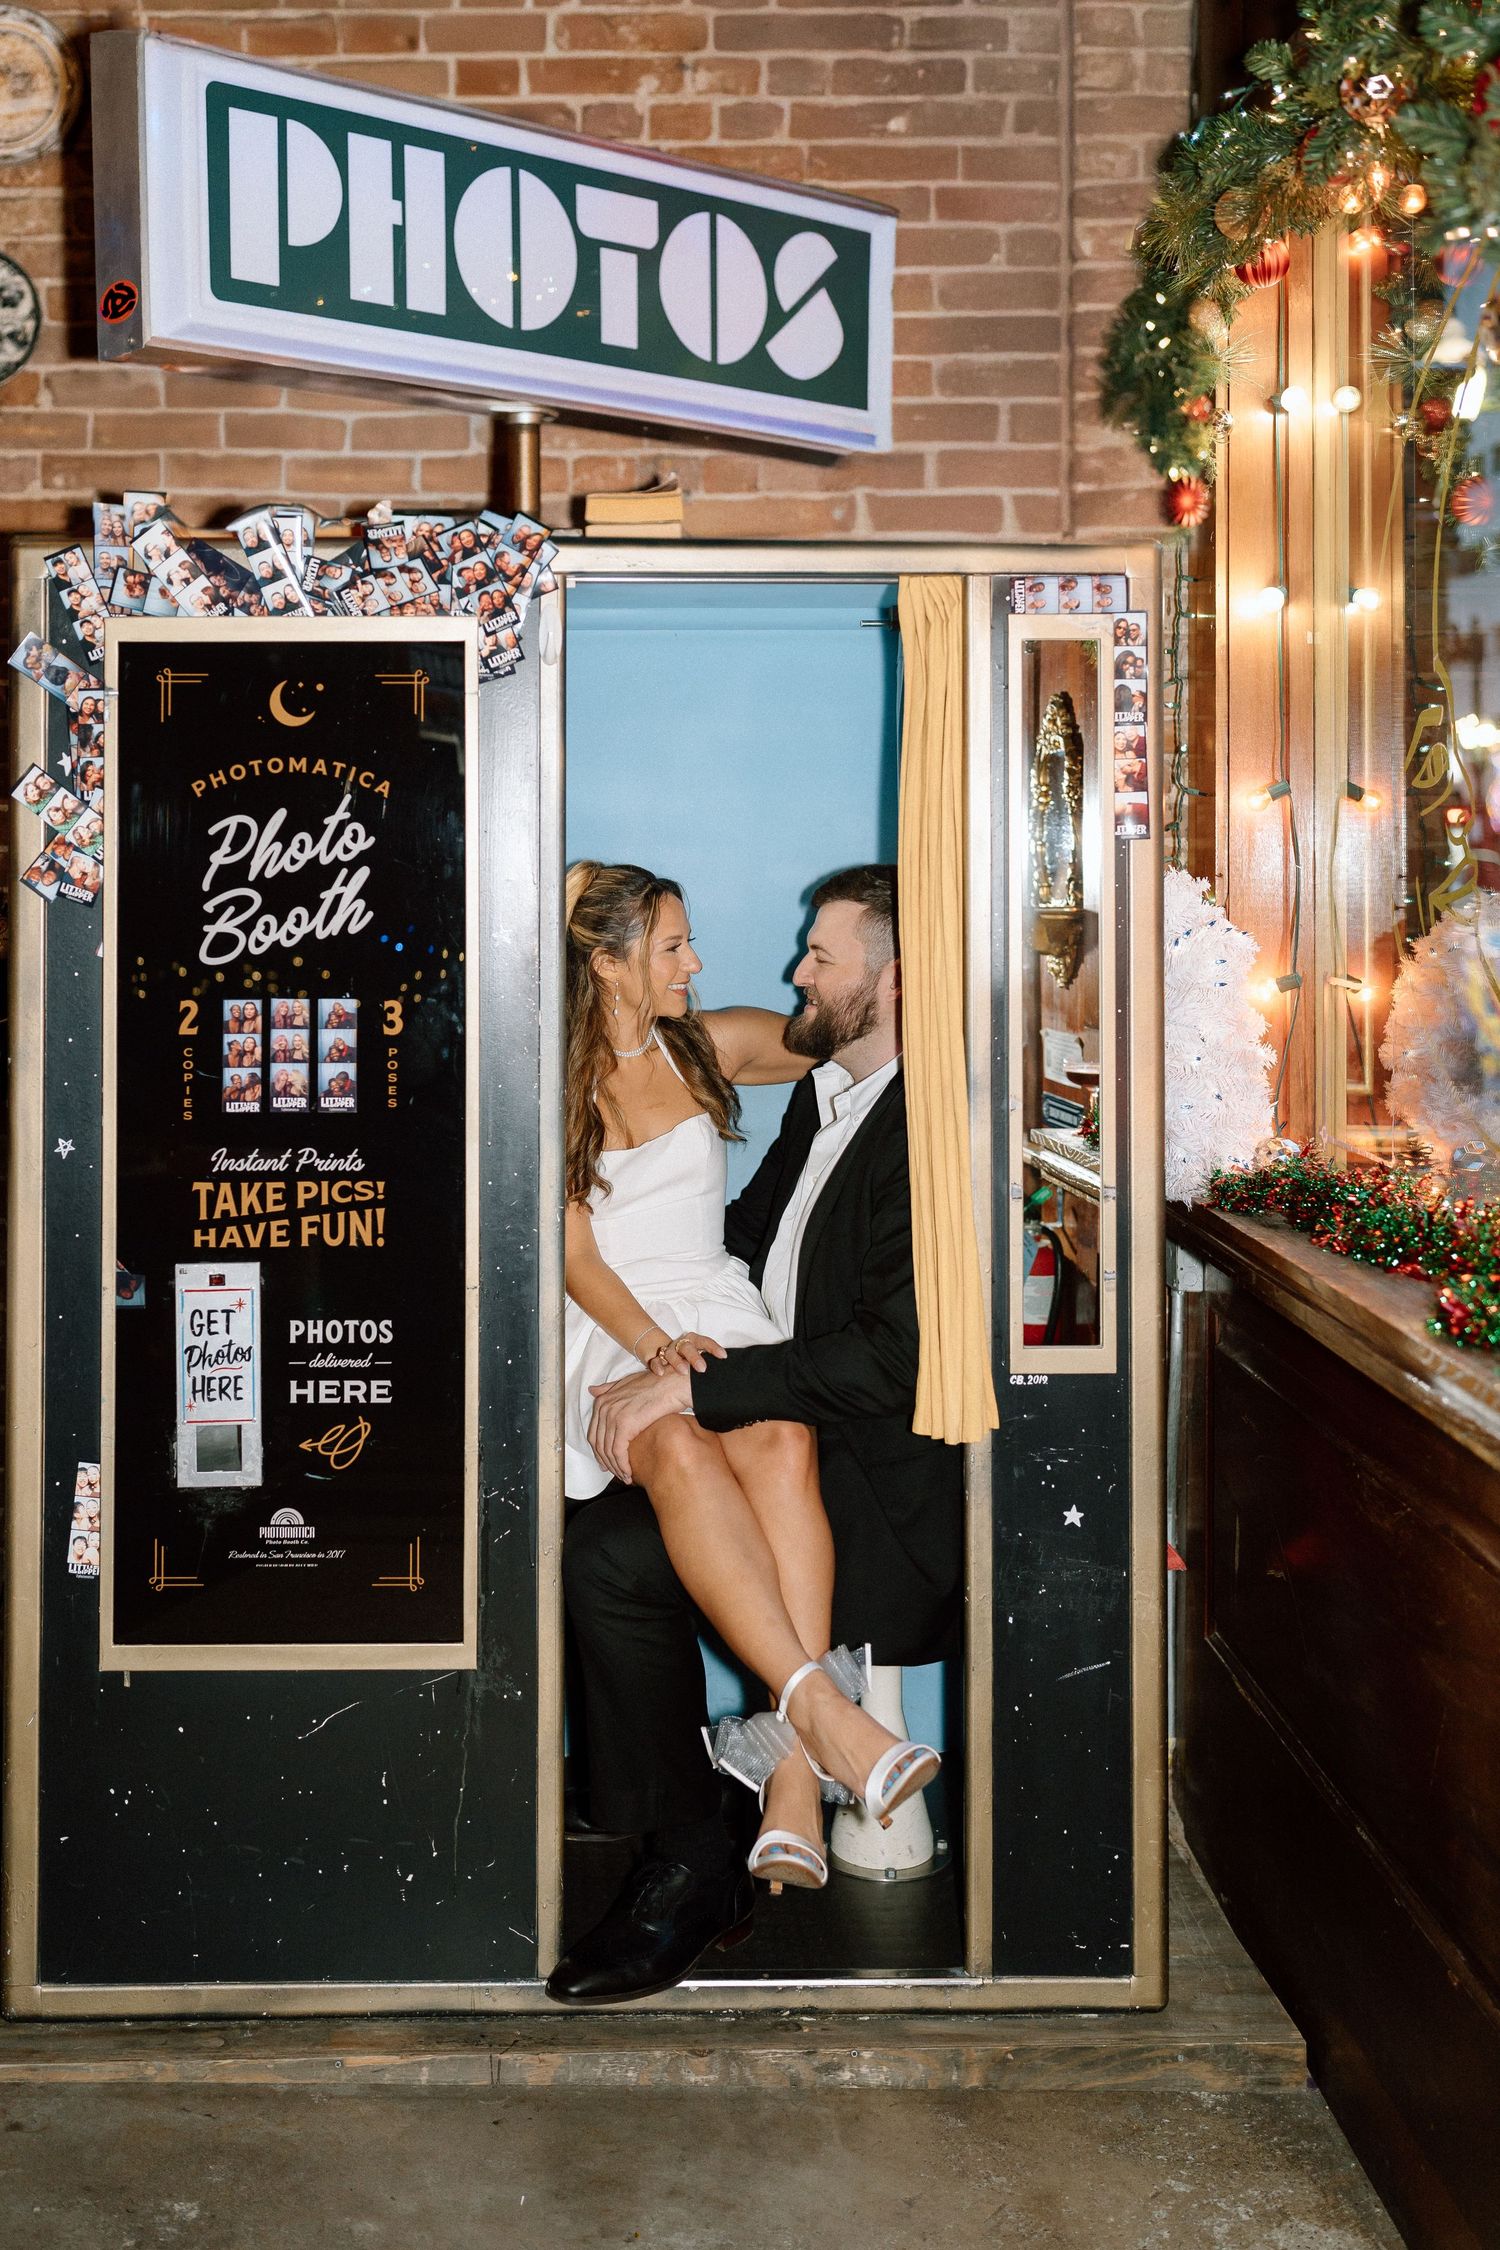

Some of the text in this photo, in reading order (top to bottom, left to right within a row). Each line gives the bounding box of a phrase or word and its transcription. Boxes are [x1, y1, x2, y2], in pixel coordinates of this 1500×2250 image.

[228, 106, 844, 381] PHOTOS
[191, 757, 391, 798] PHOTOMATICA
[202, 793, 376, 892] Photo
[198, 866, 374, 966] Booth
[178, 1000, 199, 1035] 2
[383, 1000, 404, 1036] 3
[183, 1047, 193, 1121] COPIES
[387, 1047, 398, 1108] POSES
[210, 1147, 366, 1173] Instant Prints
[192, 1180, 386, 1220] TAKE PICS!
[193, 1207, 386, 1248] HAVE FUN!
[189, 1308, 237, 1338] GET
[289, 1319, 393, 1344] PHOTOS
[184, 1338, 254, 1377] Photos
[308, 1352, 373, 1368] delivered
[191, 1375, 244, 1403] HERE
[289, 1379, 393, 1404] HERE
[259, 1526, 316, 1539] PHOTOMATICA
